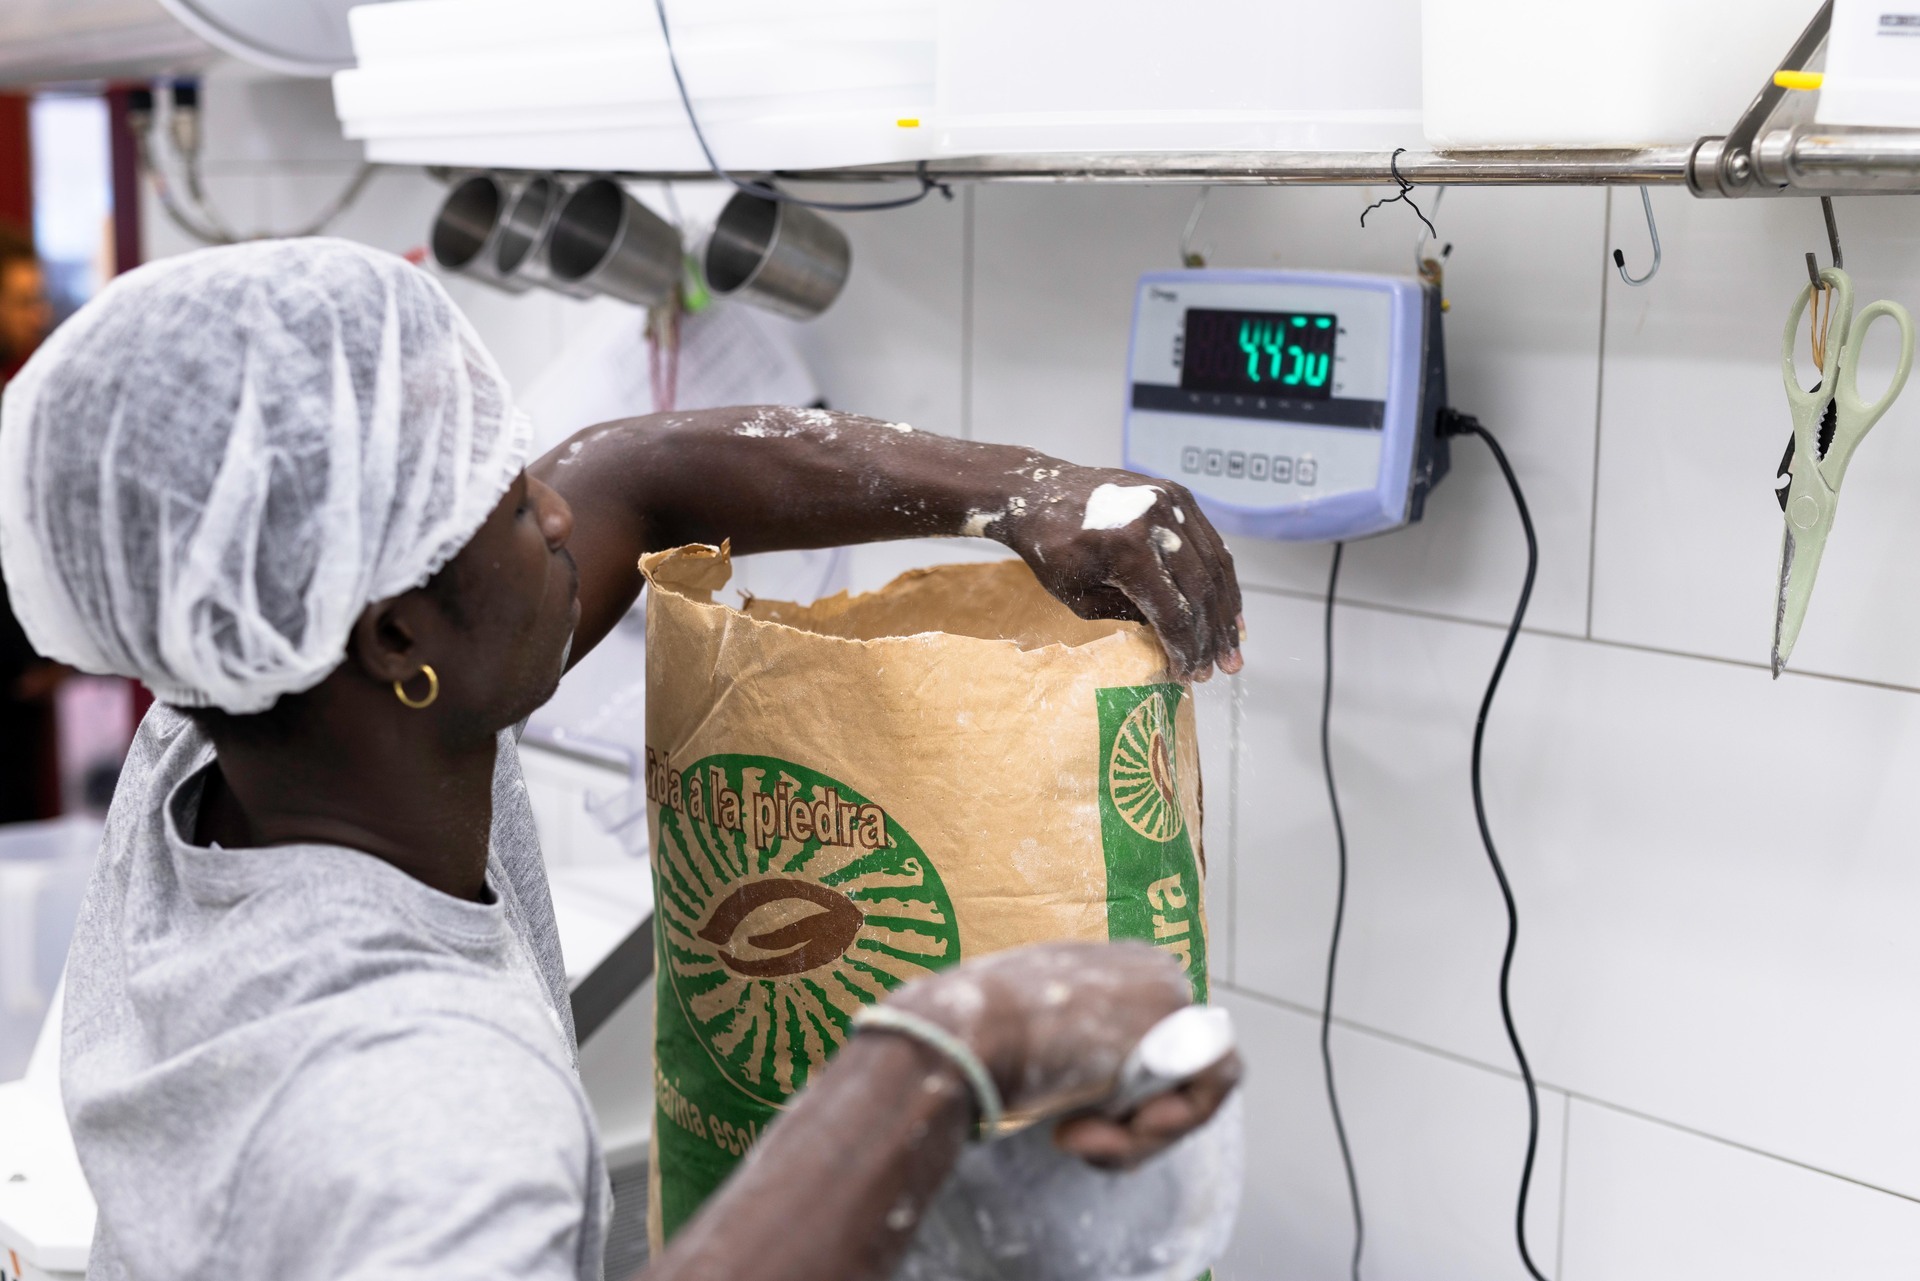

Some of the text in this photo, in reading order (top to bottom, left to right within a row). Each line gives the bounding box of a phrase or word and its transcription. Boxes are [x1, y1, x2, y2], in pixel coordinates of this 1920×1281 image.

[690, 777, 705, 823] a
[710, 769, 744, 832] la
[753, 781, 888, 850] piedra
